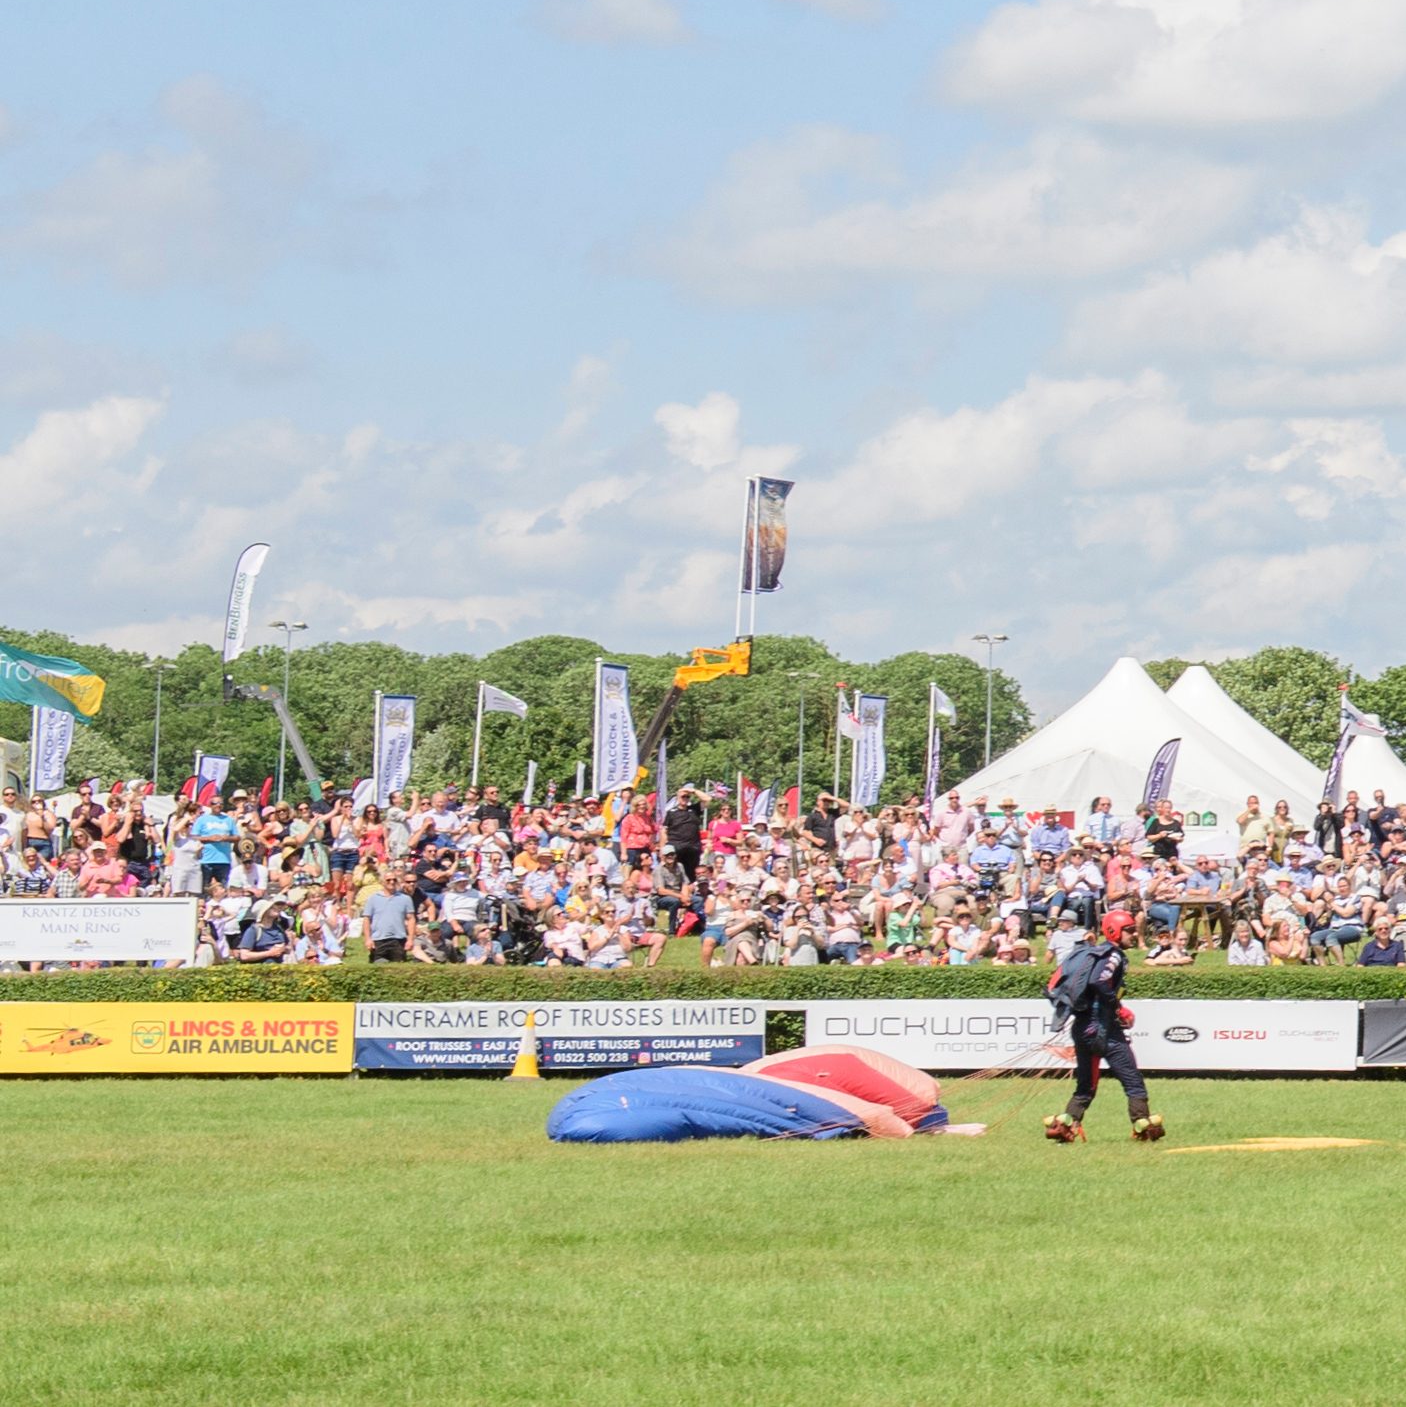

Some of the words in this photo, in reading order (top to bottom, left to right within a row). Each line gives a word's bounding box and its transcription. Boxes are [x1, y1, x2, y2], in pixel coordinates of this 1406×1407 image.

[609, 712, 617, 720] &
[43, 722, 56, 781] PEACOCK
[607, 724, 618, 782] PEACOCK
[360, 1009, 489, 1028] LINCFRAME
[498, 1009, 562, 1028] ROOF
[570, 1008, 664, 1027] TRUSSES
[673, 1007, 758, 1026] LIMITED
[168, 1021, 234, 1037] LINCS
[242, 1021, 257, 1036] &
[262, 1020, 340, 1037] NOTTS
[1213, 1030, 1267, 1040] ISUZU
[168, 1039, 202, 1054] AIR
[207, 1038, 338, 1054] AMBULANCE
[395, 1041, 427, 1052] ROOF
[428, 1040, 473, 1052] TRUSSES
[482, 1040, 507, 1052] EASI
[551, 1040, 596, 1051] FEATURE
[598, 1039, 641, 1051] TRUSSES
[651, 1038, 696, 1050] GLULAM
[697, 1037, 735, 1050] BEAMS
[934, 1042, 998, 1052] MOTOR
[553, 1053, 585, 1063] 01522
[586, 1052, 608, 1063] 500
[608, 1051, 629, 1063] 238
[651, 1051, 711, 1063] LINCFRAME
